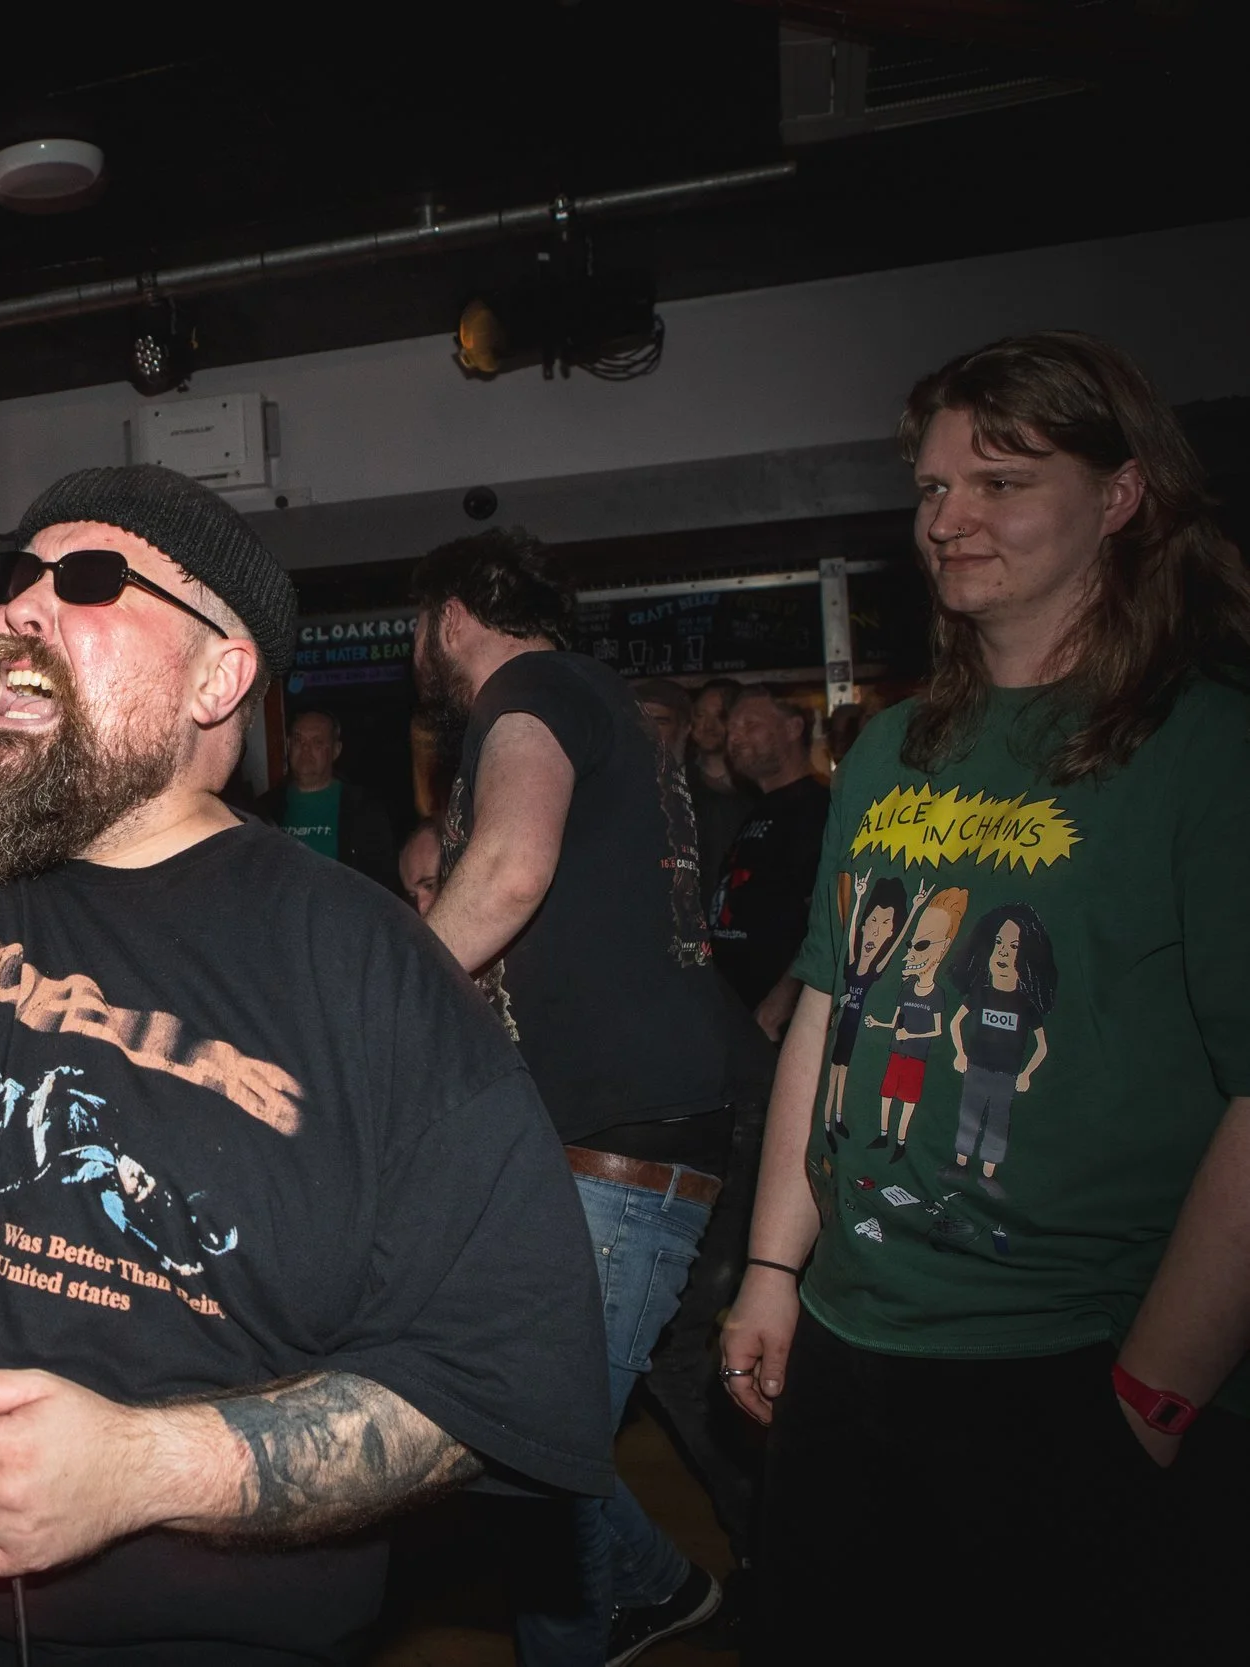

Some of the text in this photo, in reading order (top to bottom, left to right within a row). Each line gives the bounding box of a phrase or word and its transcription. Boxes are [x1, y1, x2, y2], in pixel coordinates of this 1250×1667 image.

[628, 601, 674, 626] CRAFT
[325, 645, 369, 663] WATER
[370, 644, 382, 660] &
[382, 642, 411, 660] EAR
[856, 801, 1046, 848] ALICE IN CHAINS
[984, 1012, 1015, 1027] TOOL
[4, 1222, 44, 1254] Was
[46, 1235, 115, 1274] Better
[117, 1257, 172, 1292] Than
[66, 1278, 131, 1311] states
